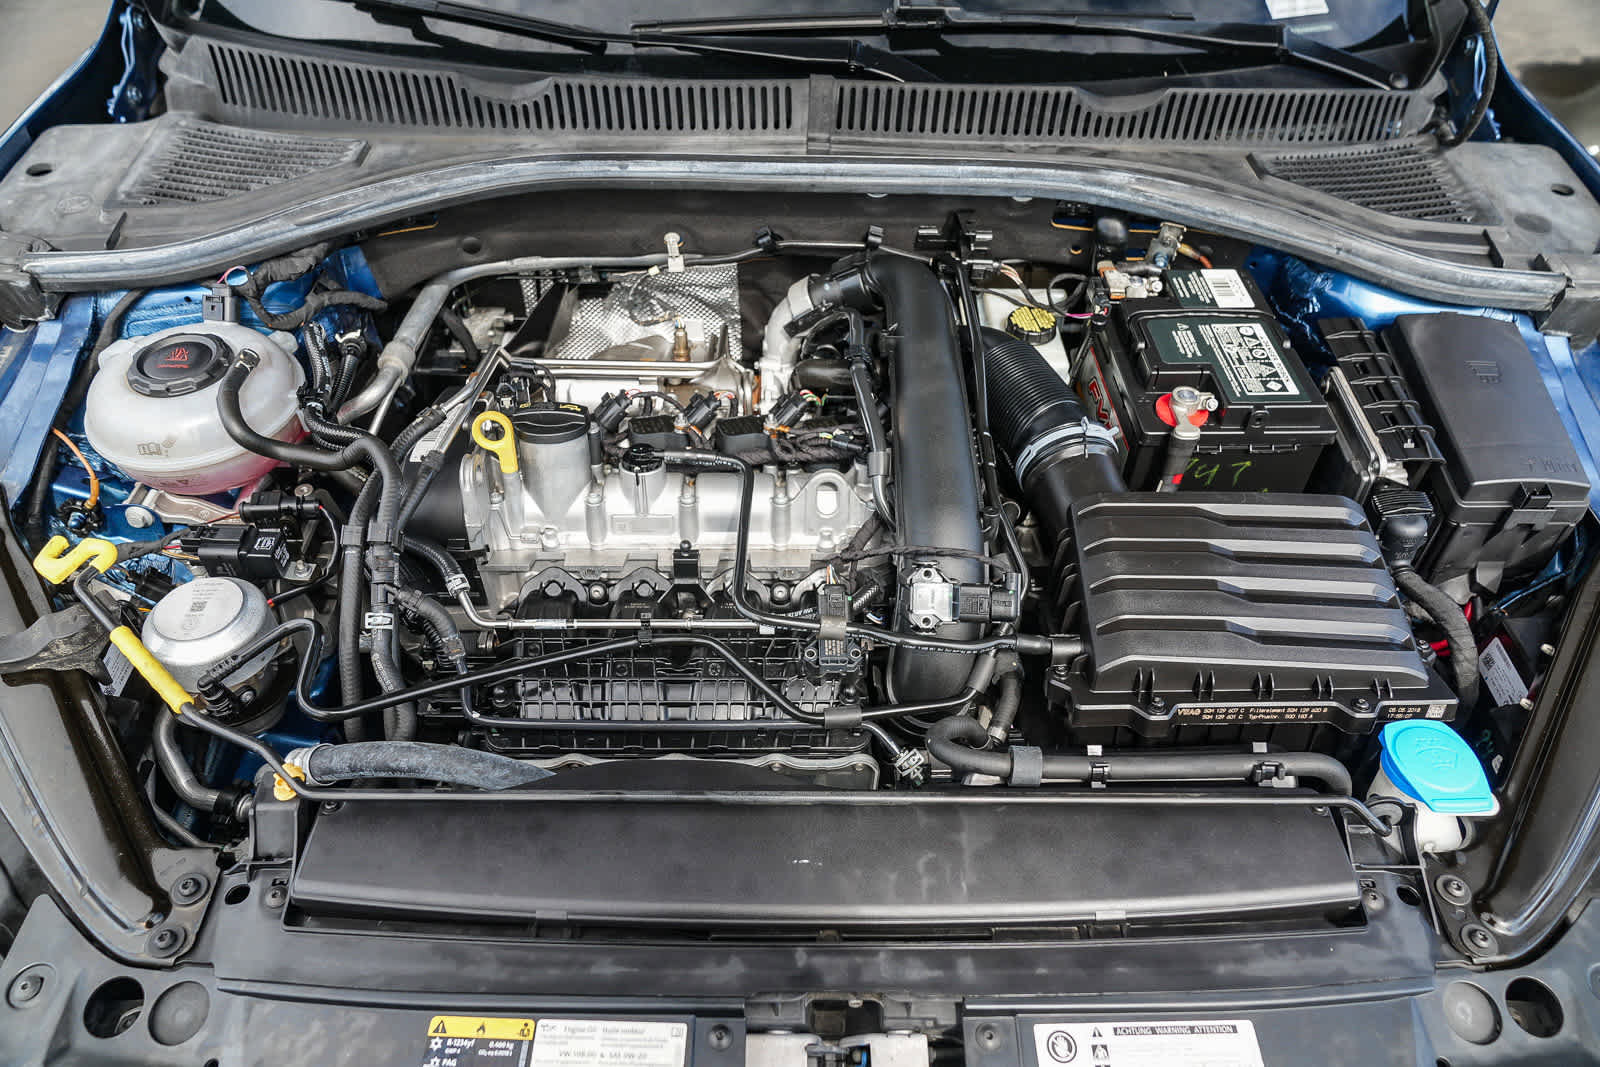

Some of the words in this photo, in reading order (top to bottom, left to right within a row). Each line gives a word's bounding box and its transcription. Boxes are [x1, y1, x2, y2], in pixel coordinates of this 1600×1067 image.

[1115, 1026, 1152, 1036] ACHTUNG
[1154, 1025, 1190, 1035] WARNING
[1193, 1024, 1234, 1034] ATTENTION
[441, 1058, 458, 1067] PAG
